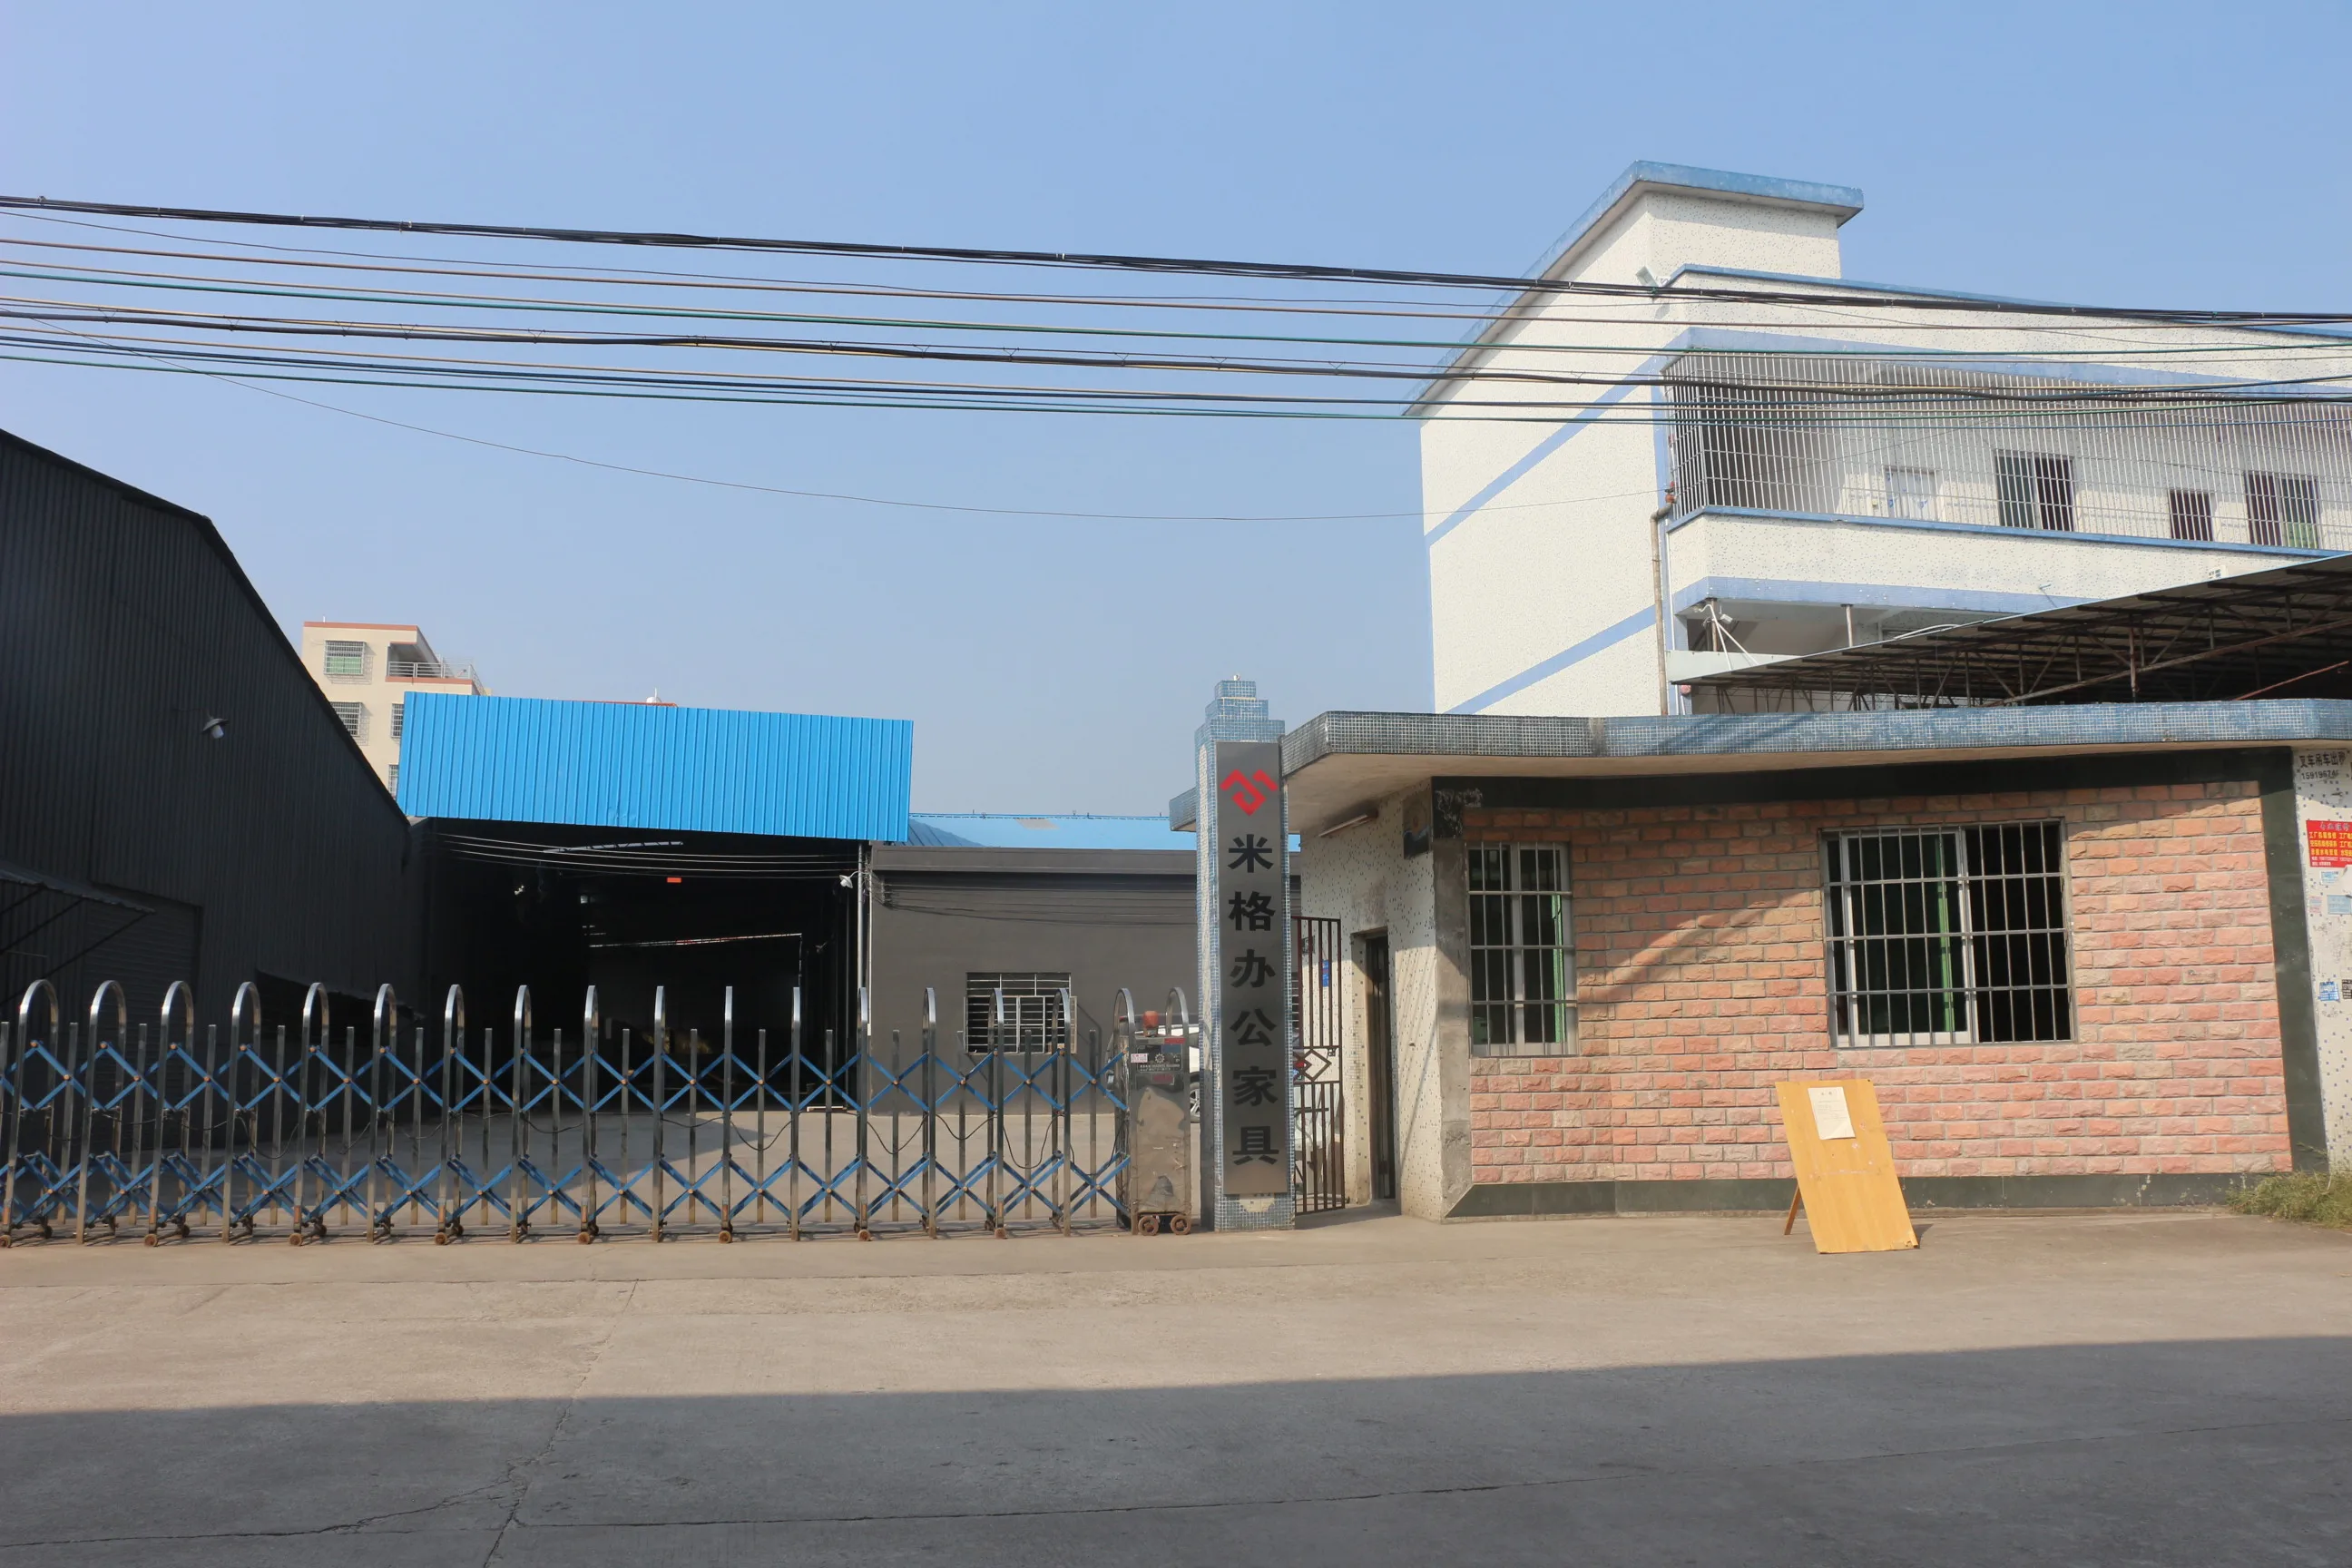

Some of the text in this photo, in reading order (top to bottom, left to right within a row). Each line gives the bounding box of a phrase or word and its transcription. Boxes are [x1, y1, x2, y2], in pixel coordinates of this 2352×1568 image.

[1228, 833, 1279, 1165] 米格办公家具
